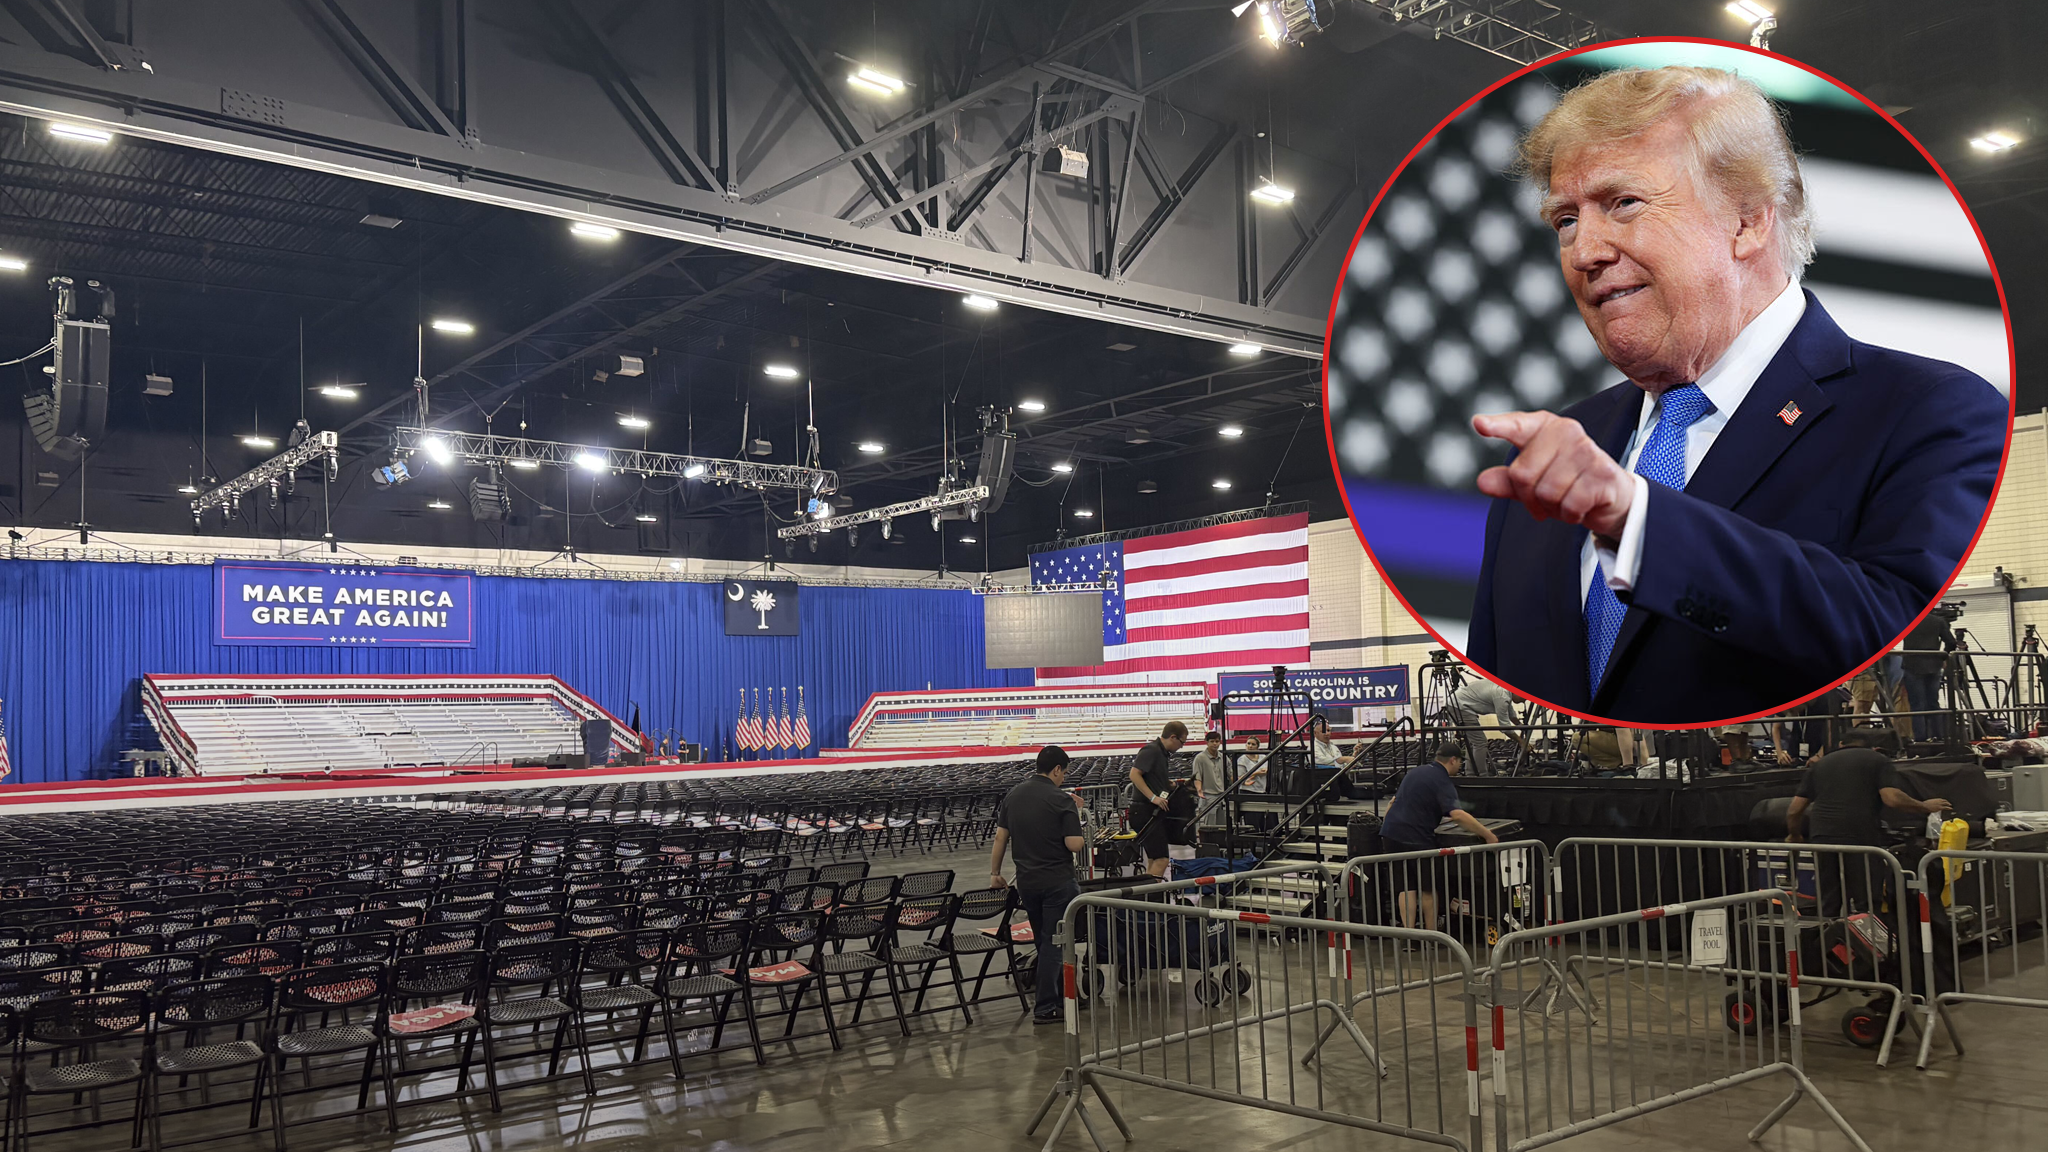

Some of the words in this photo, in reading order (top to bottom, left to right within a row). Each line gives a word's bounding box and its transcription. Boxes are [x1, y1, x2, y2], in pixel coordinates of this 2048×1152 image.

[243, 584, 323, 604] MAKE
[334, 587, 454, 608] AMERICA
[251, 606, 345, 626] GREAT
[355, 609, 447, 628] AGAIN!
[1295, 677, 1354, 688] CAROLINA
[1358, 676, 1370, 686] IS
[1310, 684, 1398, 701] COUNTRY
[1698, 926, 1723, 937] TRAVEL
[1703, 939, 1721, 950] POOL
